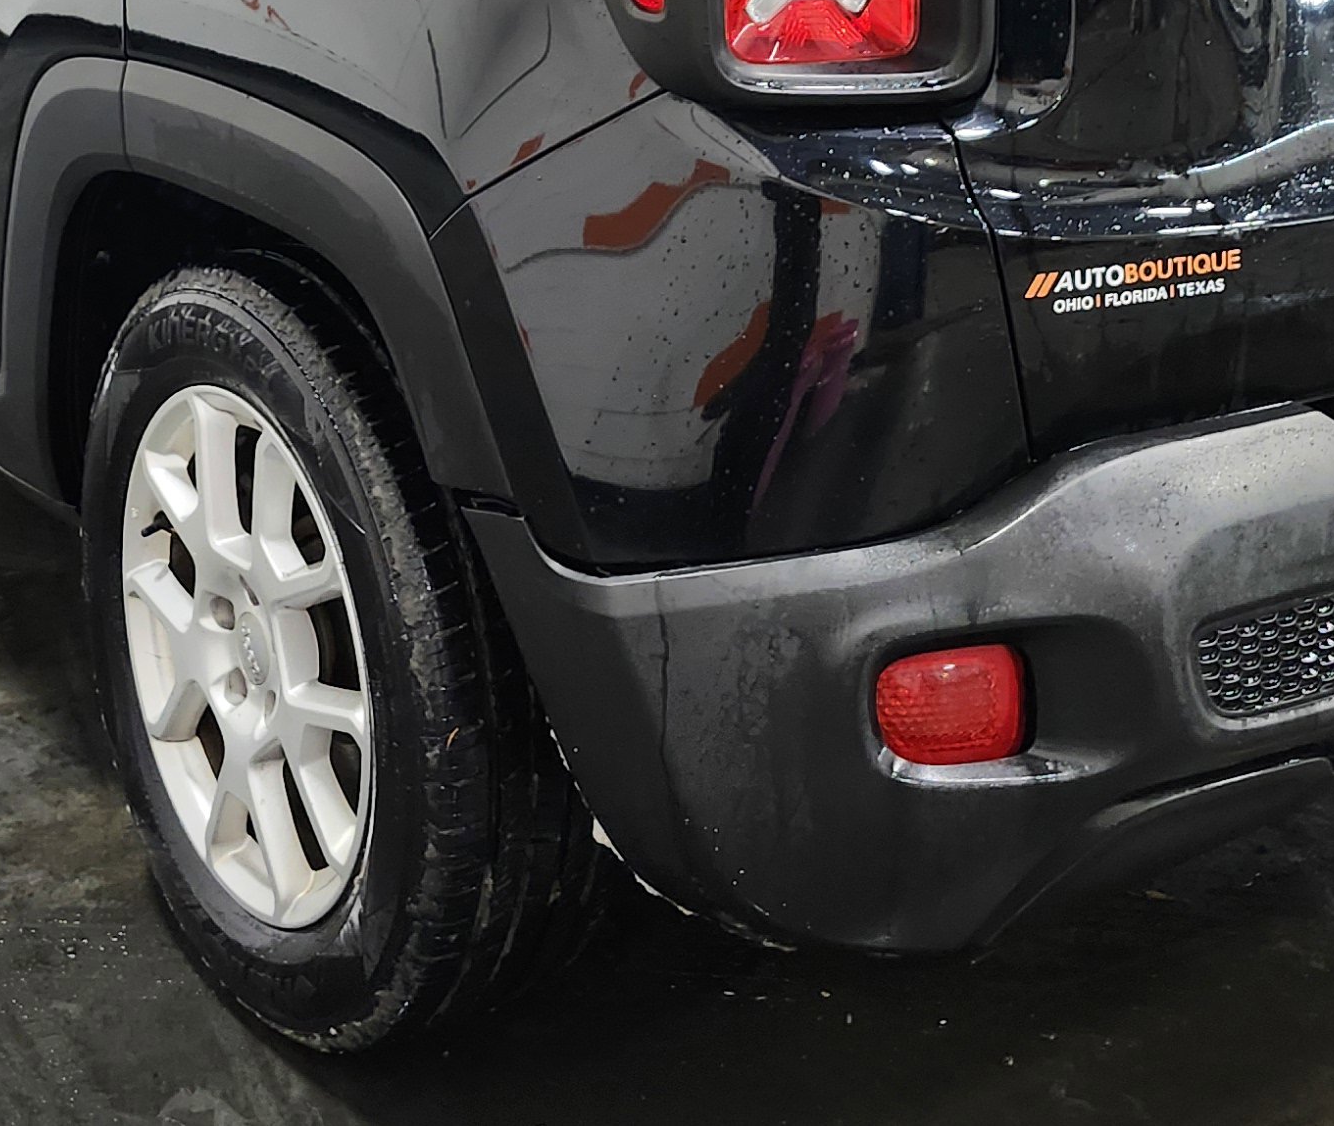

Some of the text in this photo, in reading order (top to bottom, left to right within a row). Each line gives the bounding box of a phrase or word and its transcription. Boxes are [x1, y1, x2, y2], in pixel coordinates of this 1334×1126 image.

[1053, 248, 1242, 293] AUTOBOUTIQUE
[1052, 277, 1226, 314] OHIO FLORIDA TEXAS
